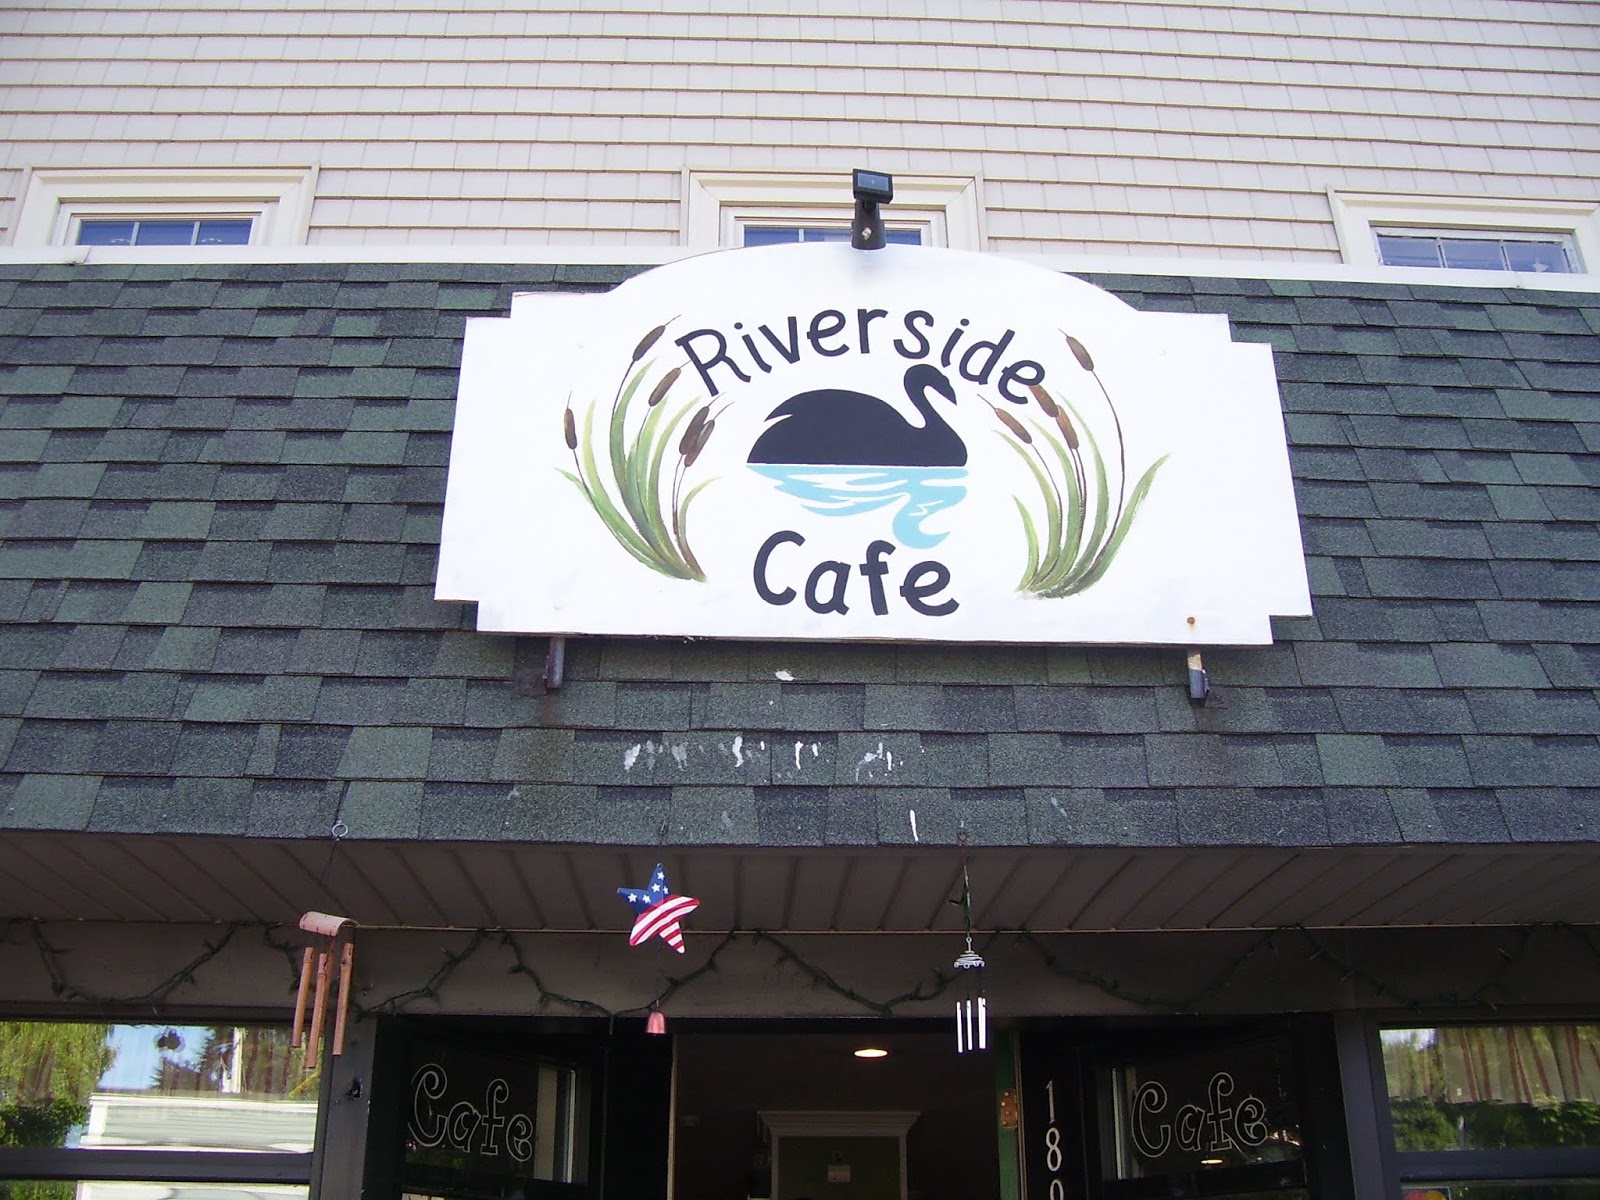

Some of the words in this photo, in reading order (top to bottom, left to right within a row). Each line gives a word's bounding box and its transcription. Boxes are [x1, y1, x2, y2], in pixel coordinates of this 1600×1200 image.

[675, 308, 1045, 405] Riverside
[753, 530, 960, 617] Cafe
[408, 1063, 534, 1162] Cafe
[1131, 1072, 1269, 1158] Cafe
